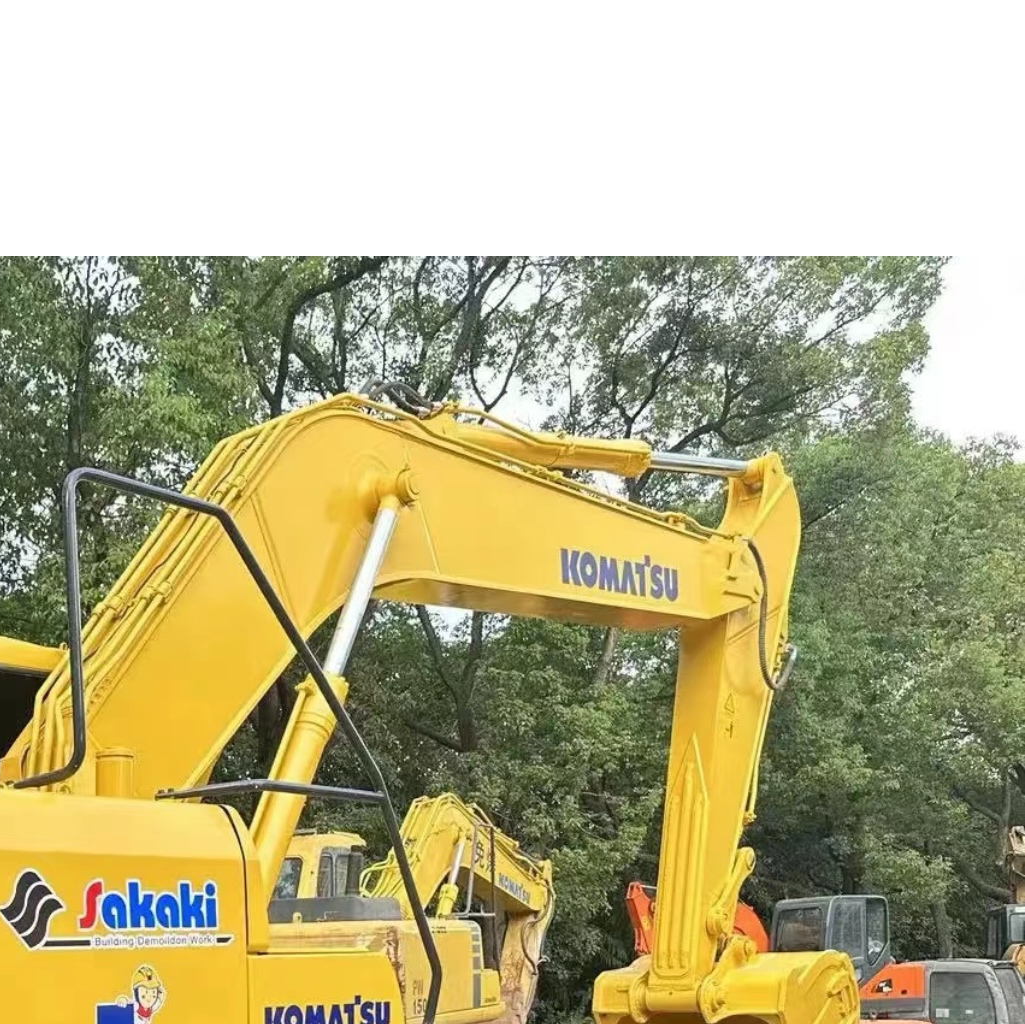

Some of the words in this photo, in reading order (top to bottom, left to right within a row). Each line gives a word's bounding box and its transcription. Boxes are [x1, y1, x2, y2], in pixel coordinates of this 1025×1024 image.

[560, 548, 679, 602] KOMATSU
[79, 881, 217, 928] Sakaki
[95, 937, 134, 947] Building
[191, 933, 213, 944] Work
